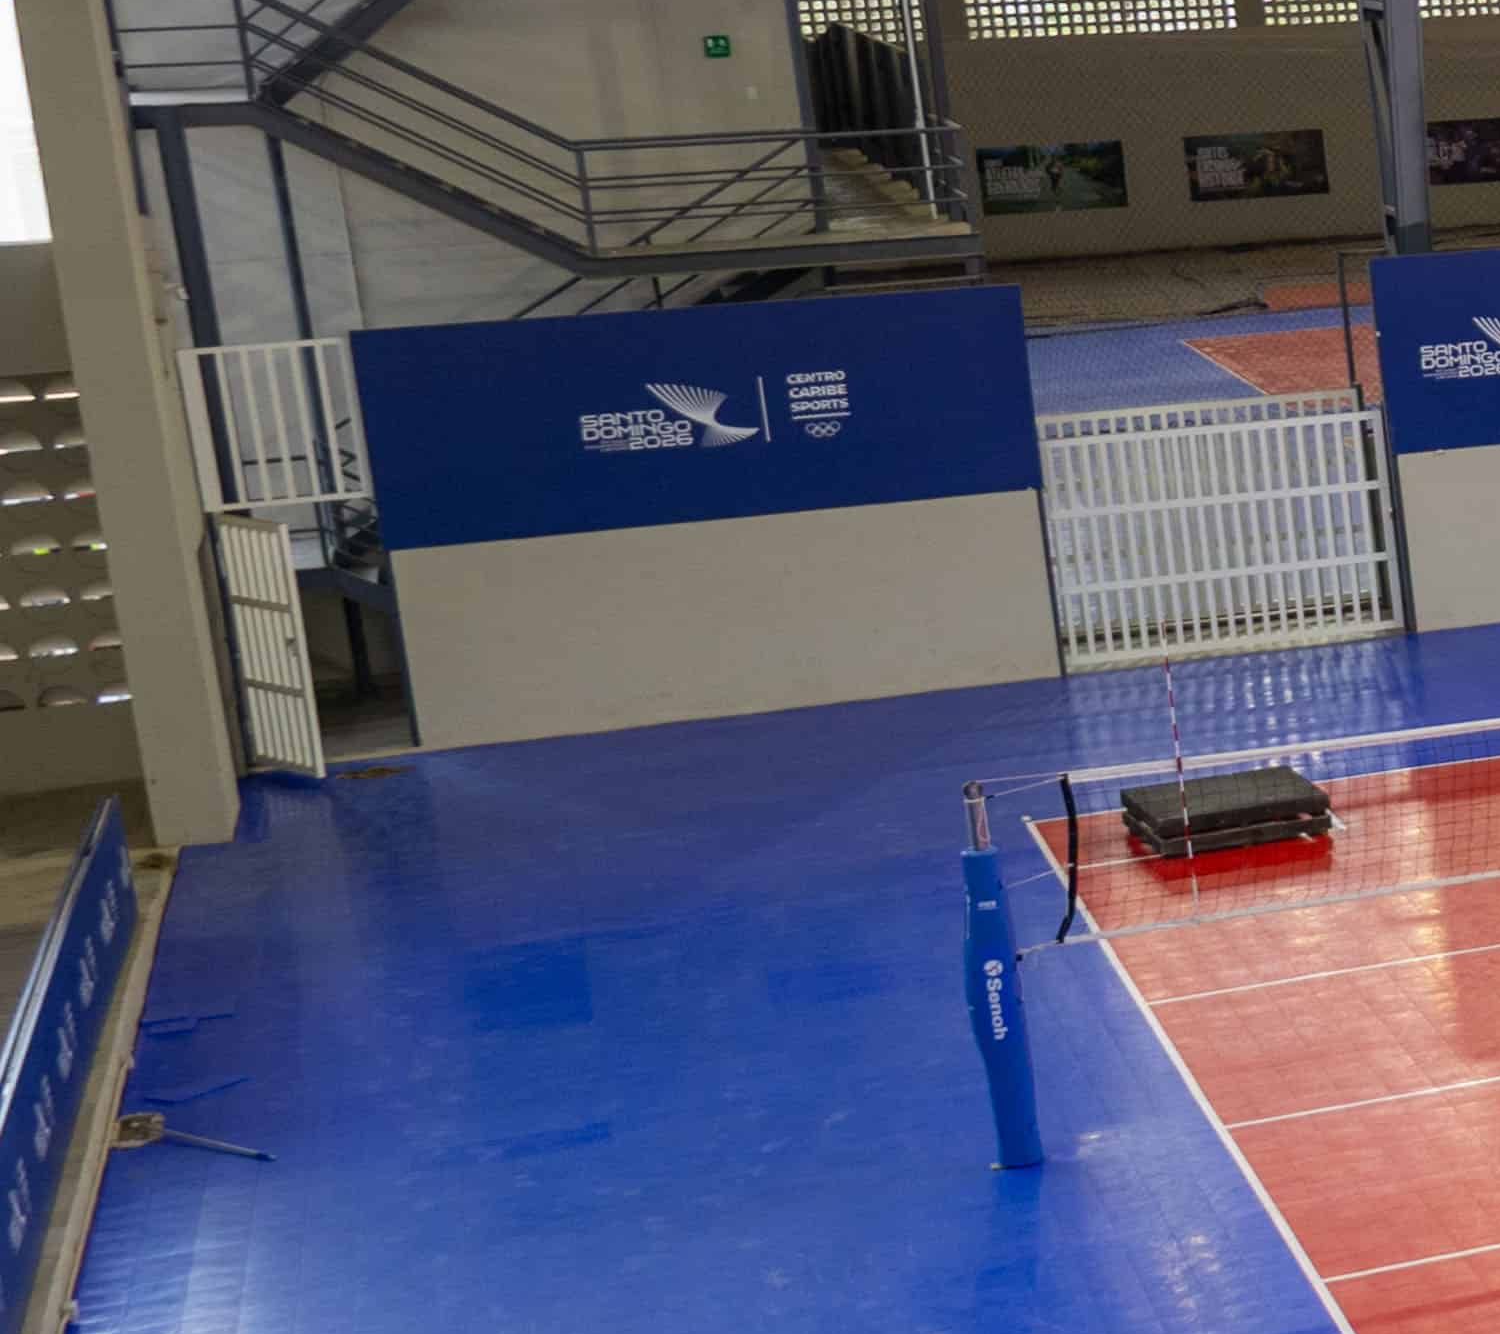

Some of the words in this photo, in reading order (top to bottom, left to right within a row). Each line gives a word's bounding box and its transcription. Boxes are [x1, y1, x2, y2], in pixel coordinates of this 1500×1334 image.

[1420, 341, 1487, 357] SANTO
[787, 370, 846, 384] CENTRO
[789, 383, 848, 399] CARIBE
[791, 398, 850, 412] SPORTS
[580, 409, 664, 427] SANTO
[582, 420, 691, 441] DOMINGO
[628, 433, 694, 450] 2026
[986, 978, 1008, 1040] Senoh
